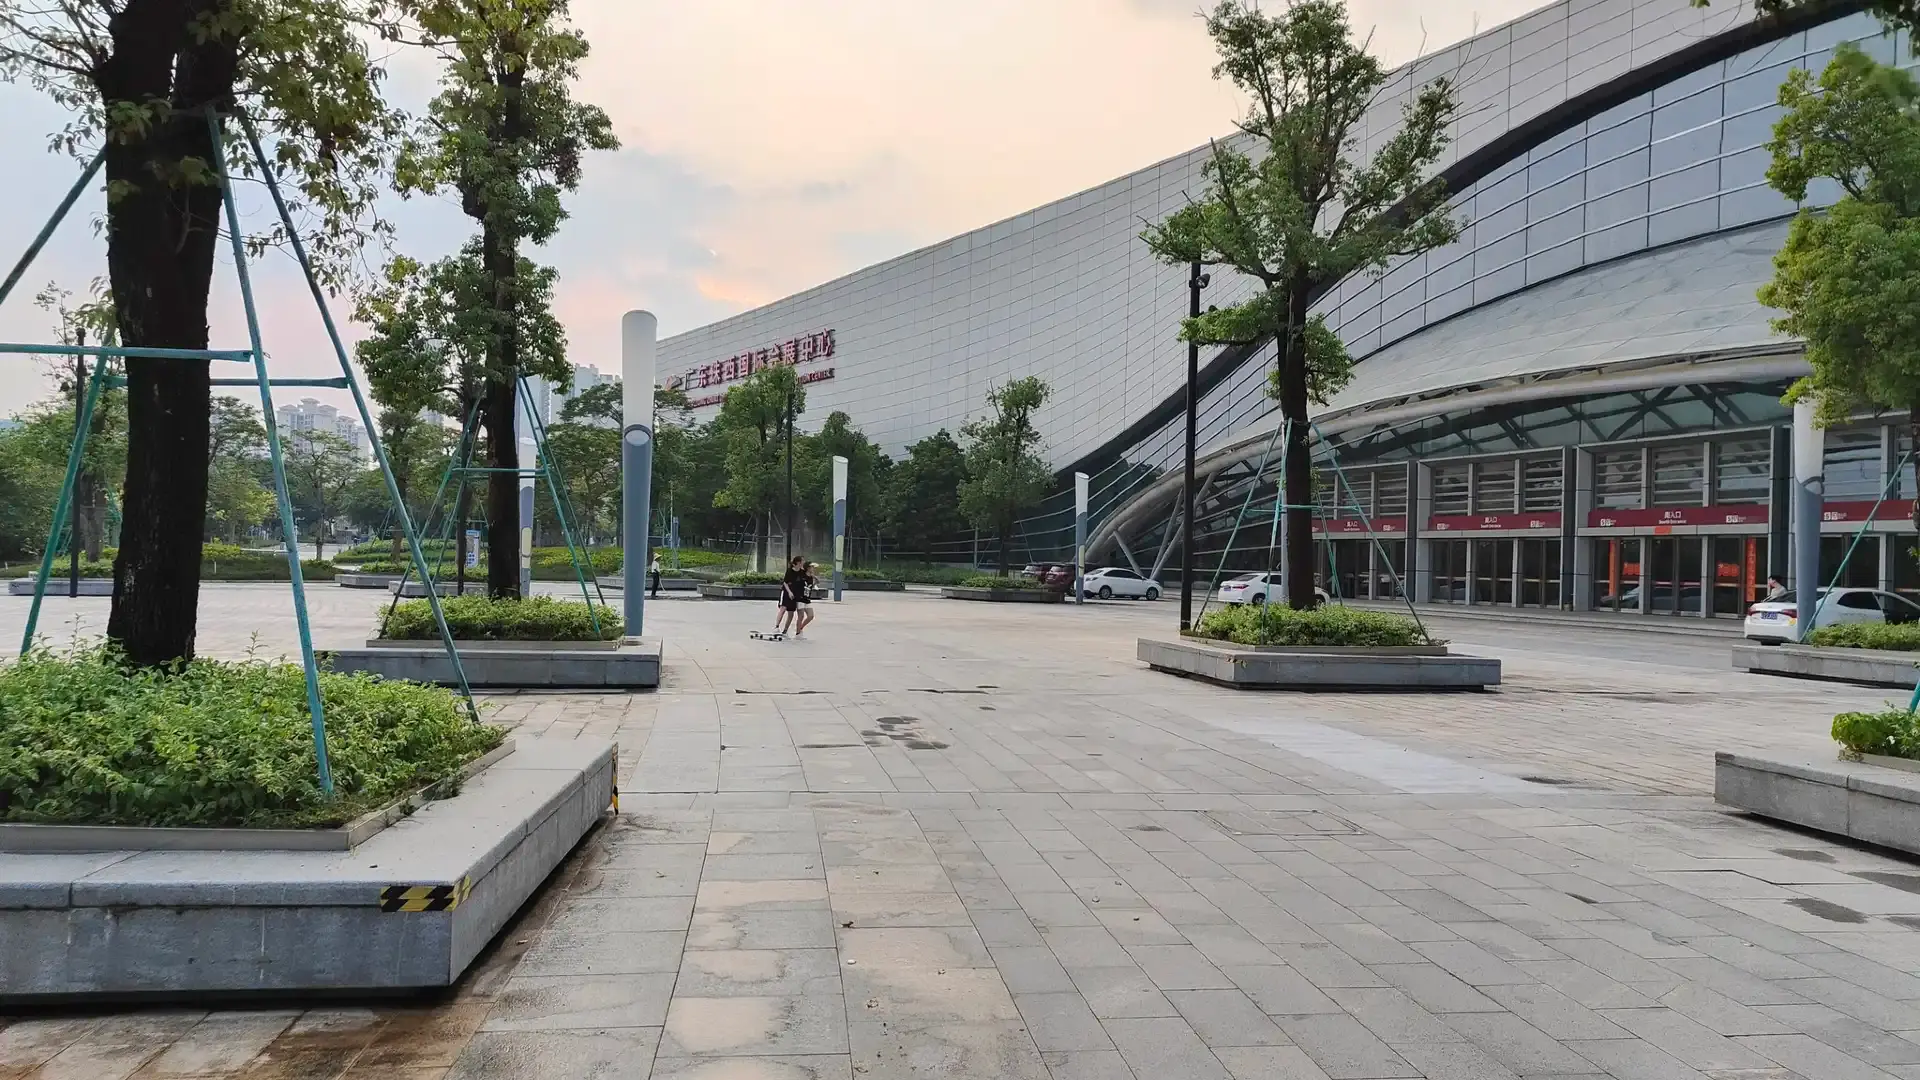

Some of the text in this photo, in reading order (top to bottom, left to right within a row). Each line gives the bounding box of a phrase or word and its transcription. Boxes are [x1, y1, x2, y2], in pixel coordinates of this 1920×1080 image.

[684, 328, 835, 390] 广东珠西国际会展中心
